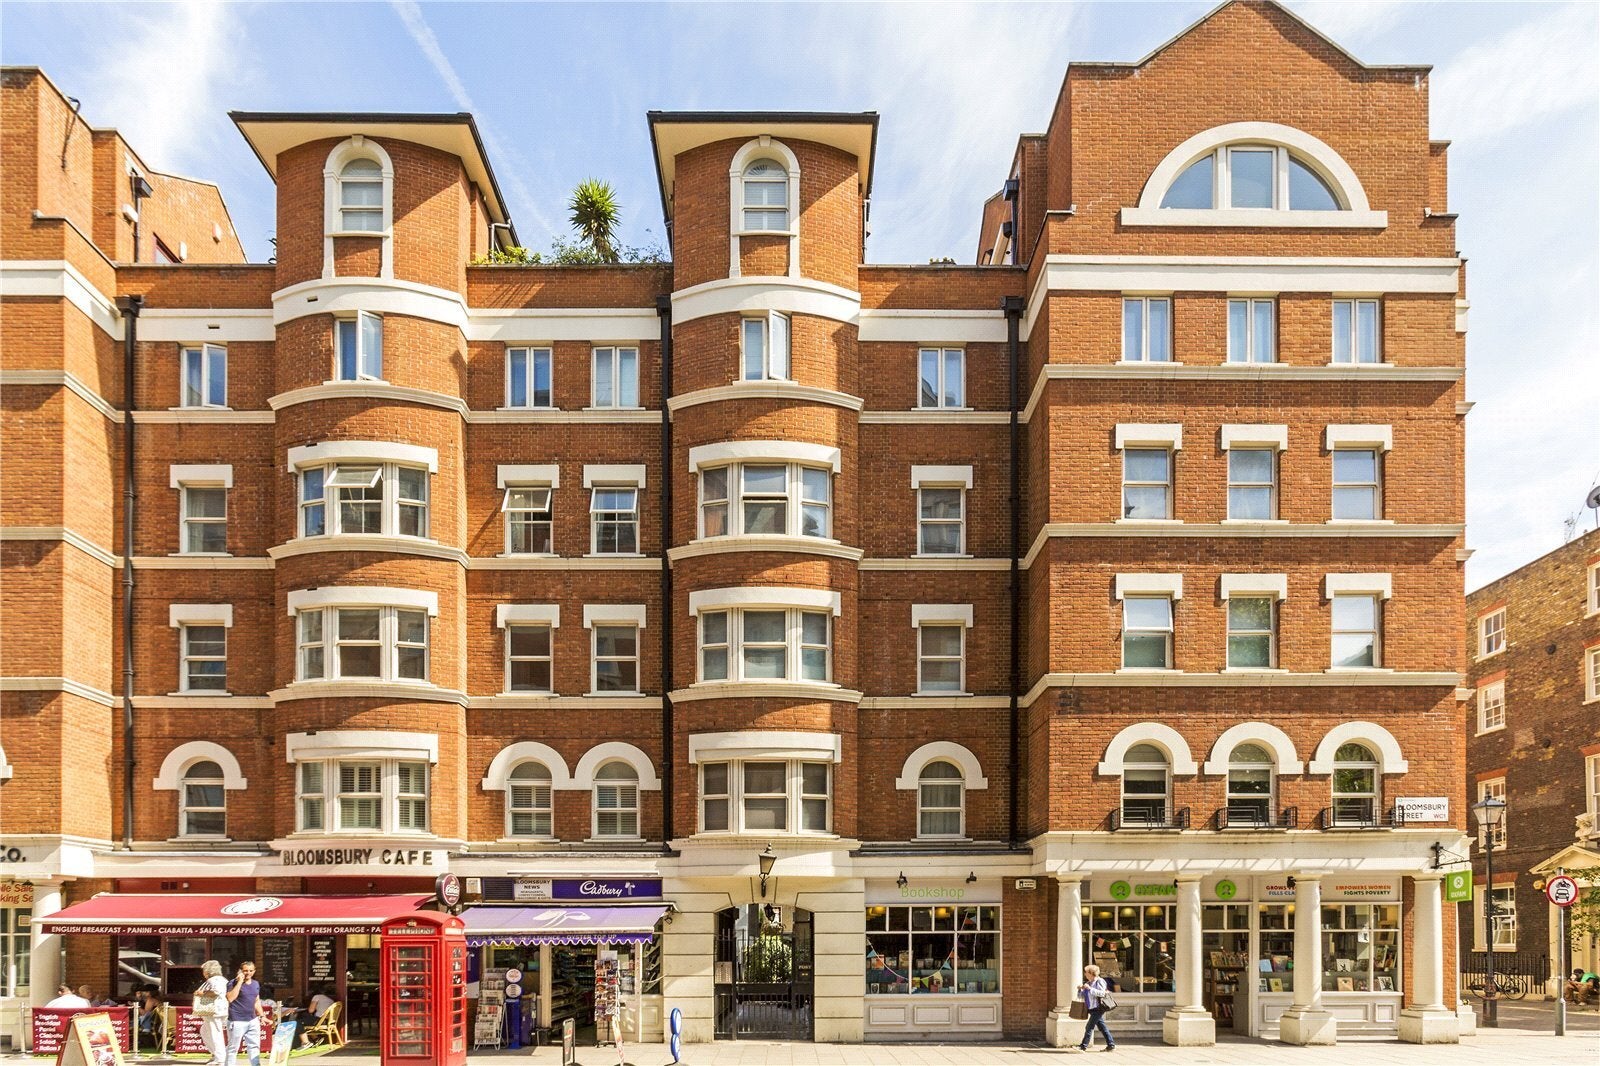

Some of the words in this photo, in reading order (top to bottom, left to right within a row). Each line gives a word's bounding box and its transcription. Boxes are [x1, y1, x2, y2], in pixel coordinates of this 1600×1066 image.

[283, 849, 373, 866] BLOOMSBURY
[381, 849, 433, 866] CAFE
[579, 880, 623, 897] Cadbury
[901, 886, 965, 899] Bookshop
[1134, 884, 1177, 896] OXFAM
[82, 926, 121, 934] BREAKFAST
